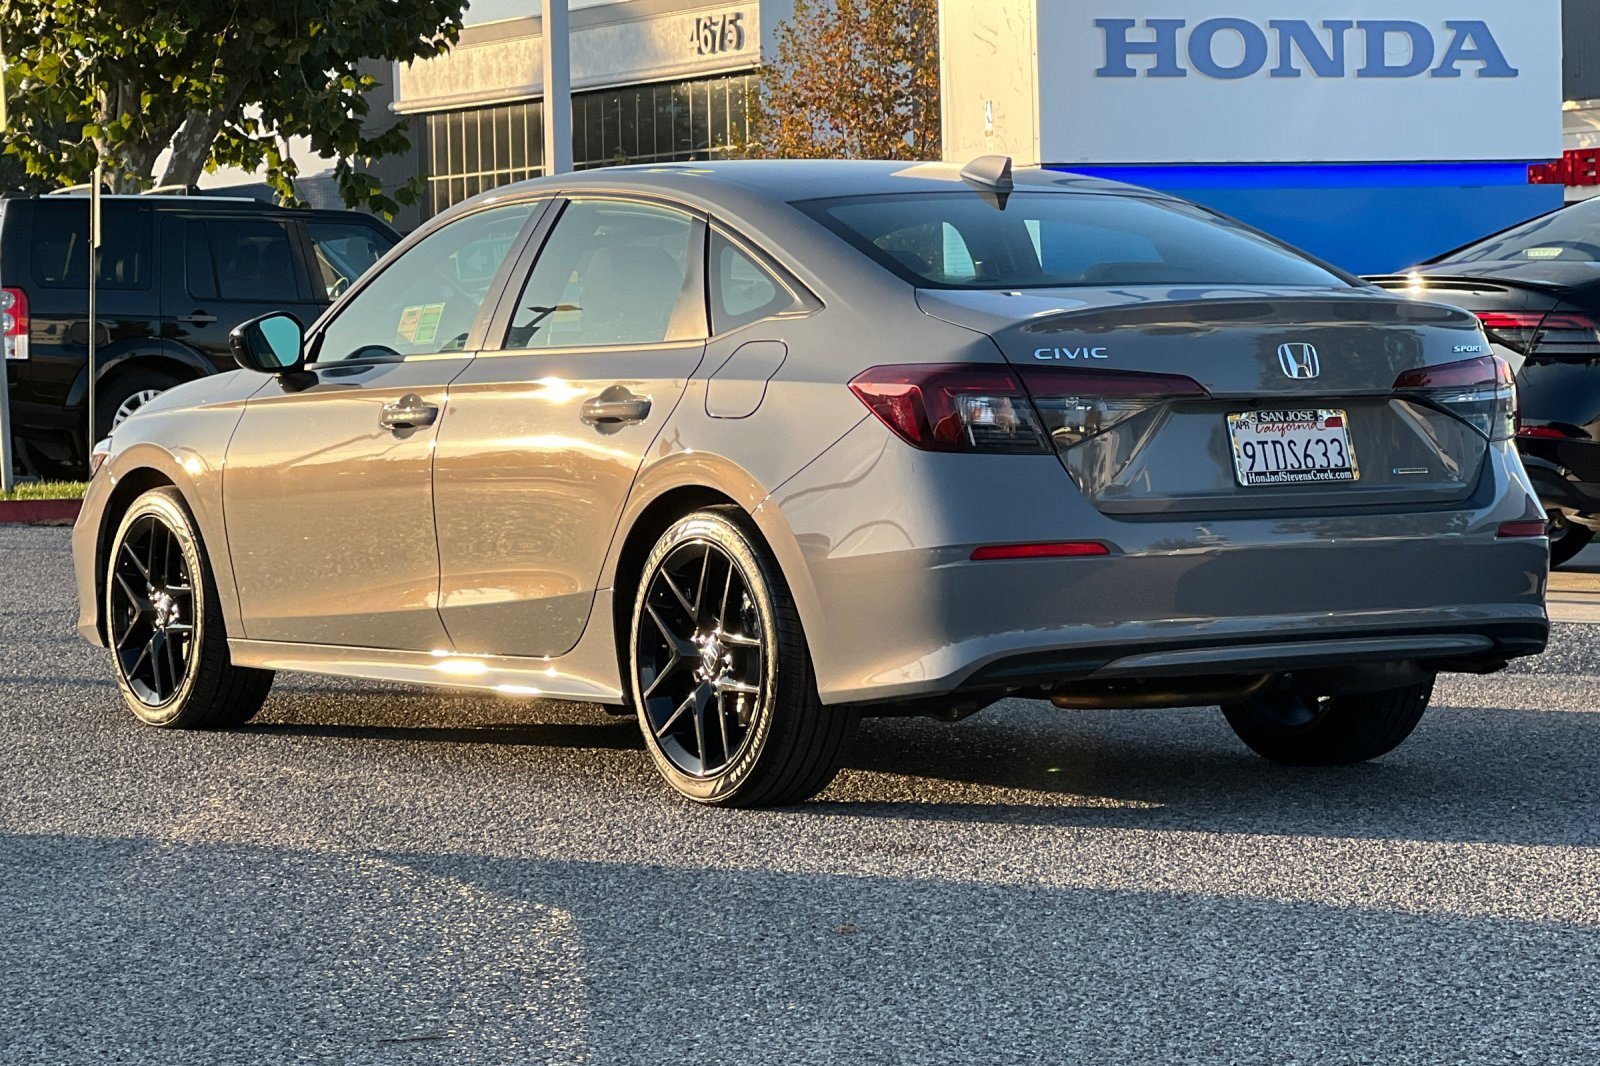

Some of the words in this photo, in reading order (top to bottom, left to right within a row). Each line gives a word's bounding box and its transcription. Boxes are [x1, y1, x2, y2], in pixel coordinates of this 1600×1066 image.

[689, 12, 745, 55] 4675
[1093, 17, 1519, 79] HONDA
[1034, 347, 1109, 360] CIVIC
[1452, 344, 1482, 353] SPORT
[1260, 411, 1284, 422] SAN
[1286, 410, 1315, 421] JOSE
[1235, 420, 1250, 430] APR
[1255, 421, 1326, 437] California
[1242, 438, 1346, 471] 9TDS633
